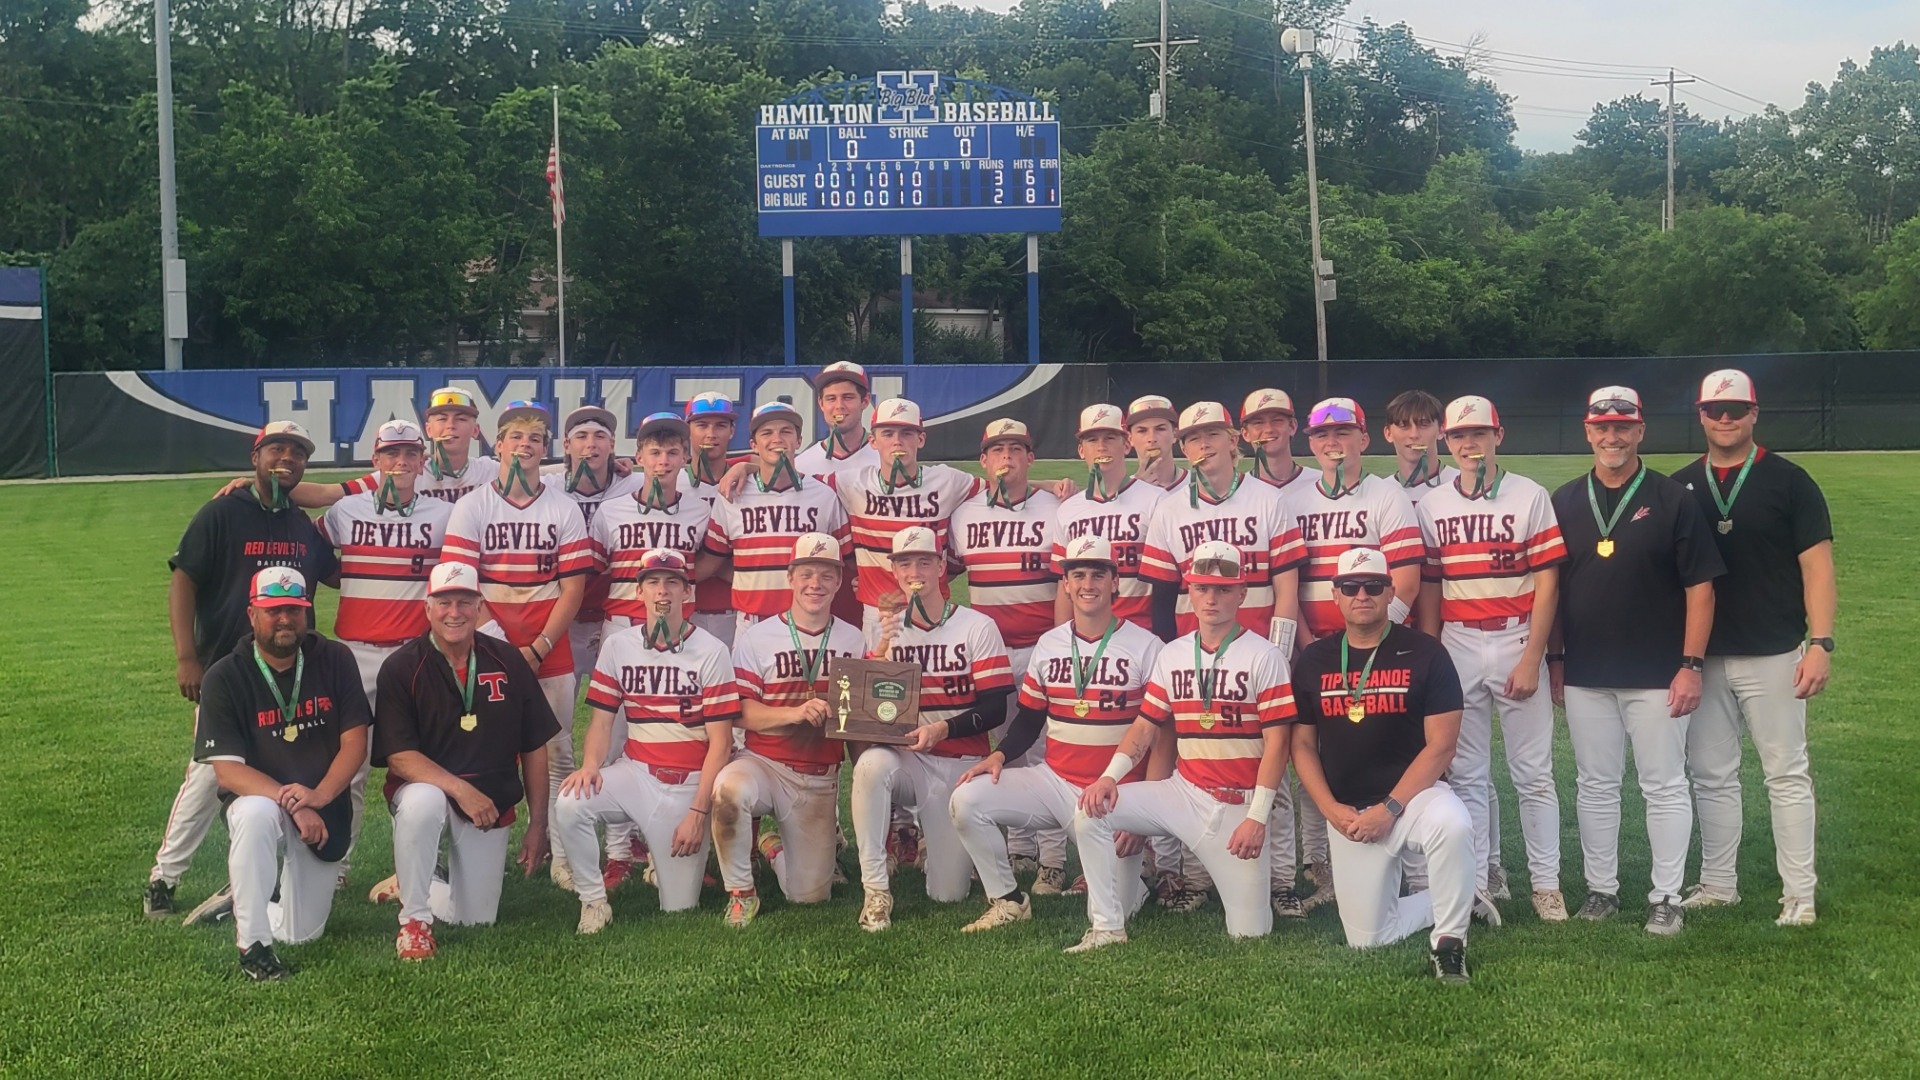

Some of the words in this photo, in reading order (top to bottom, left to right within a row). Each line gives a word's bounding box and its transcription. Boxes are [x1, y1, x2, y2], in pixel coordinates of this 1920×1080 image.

[880, 88, 903, 112] Big
[905, 88, 936, 106] Blue
[760, 104, 873, 125] HAMILTON
[944, 101, 1055, 123] BASEBALL
[771, 129, 785, 141] AT
[788, 128, 810, 140] BAT
[838, 127, 867, 140] BALL
[889, 126, 929, 139] STRIKE
[953, 126, 977, 138] OUT
[1015, 125, 1035, 138] H/E
[846, 139, 858, 159] 0
[903, 139, 915, 158] 0
[960, 138, 971, 157] 0
[817, 162, 823, 172] 1
[831, 162, 838, 171] 2
[846, 162, 852, 171] 3
[865, 162, 871, 171] 4
[880, 161, 886, 171] 5
[895, 161, 901, 171] 6
[914, 161, 920, 170] 7
[928, 161, 935, 170] 8
[943, 160, 949, 170] 9
[960, 160, 971, 170] 10
[979, 159, 1004, 169] RUNS
[1013, 159, 1034, 169] HITS
[1040, 159, 1058, 169] ERR
[764, 174, 806, 189] GUEST
[994, 170, 1003, 186] 3
[1025, 170, 1035, 185] 6
[764, 193, 780, 207] BIG
[783, 192, 808, 206] BLUE
[994, 188, 1003, 203] 2
[1026, 188, 1035, 203] 8
[865, 489, 940, 518] DEVILS
[740, 505, 818, 533] DEVILS
[1297, 510, 1368, 541] DEVILS
[1435, 514, 1515, 545] DEVILS
[351, 519, 432, 549] DEVILS
[485, 522, 557, 550] DEVILS
[618, 521, 697, 550] DEVILS
[966, 520, 1045, 549] DEVILS
[244, 541, 265, 555] RED
[1114, 545, 1137, 567] 26
[1489, 548, 1516, 570] 32
[411, 554, 424, 574] 9
[536, 553, 553, 575] 19
[1020, 552, 1042, 573] 18
[892, 643, 967, 672] DEVILS
[477, 671, 508, 702] T
[621, 665, 699, 695] DEVILS
[943, 675, 970, 697] 20
[679, 698, 692, 718] 2
[1098, 689, 1128, 712] 24
[1220, 705, 1243, 728] 51
